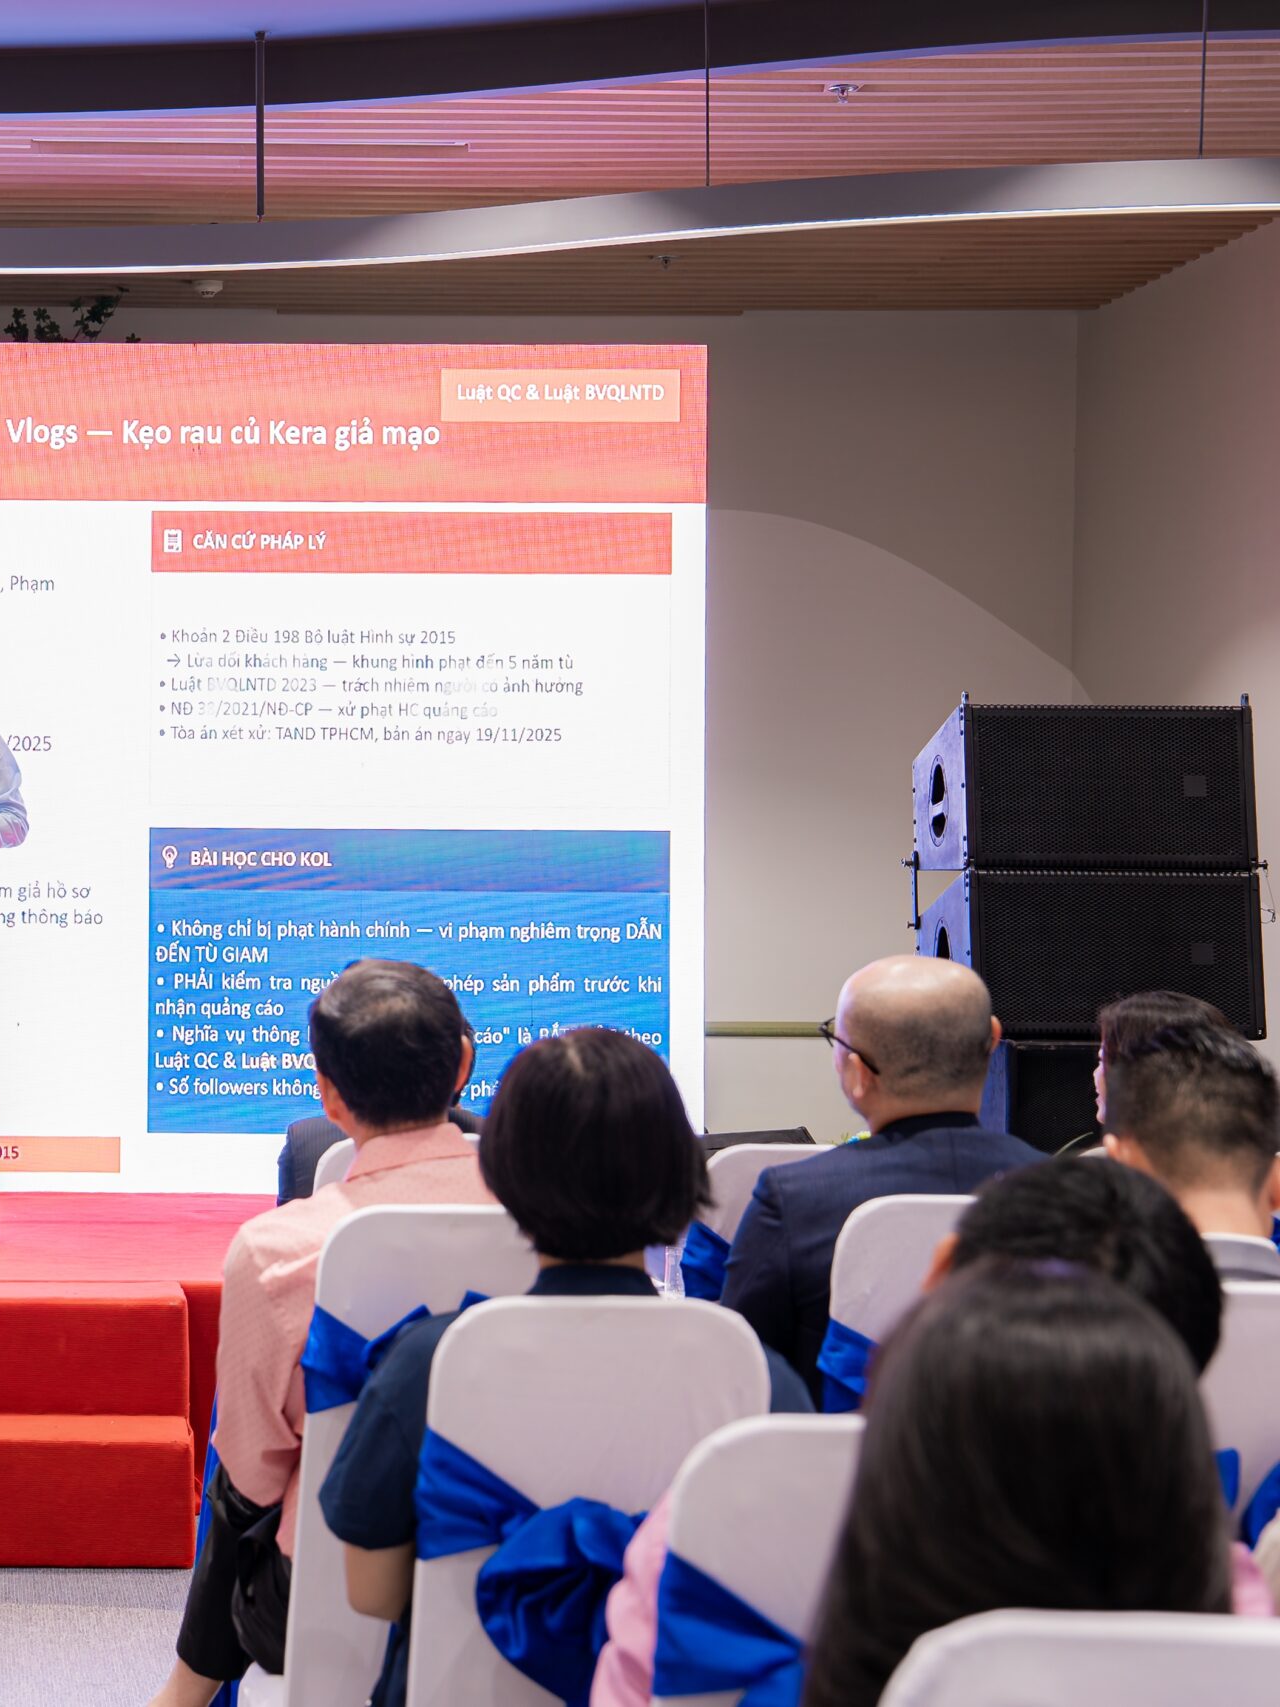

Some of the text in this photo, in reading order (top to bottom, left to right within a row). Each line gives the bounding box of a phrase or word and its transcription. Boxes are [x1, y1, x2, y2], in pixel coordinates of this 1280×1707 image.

[458, 383, 664, 405] Luật QC & Luật BVQLNTD
[6, 415, 77, 449] Vlogs
[123, 417, 171, 449] Kẹo
[181, 424, 221, 444] rau
[231, 416, 259, 444] củ
[270, 418, 326, 444] Kera
[335, 416, 373, 451] giả
[383, 425, 439, 451] mạo
[193, 530, 326, 551] CĂN CỨ PHÁP LÝ
[11, 575, 54, 594] Phạm
[223, 630, 230, 644] 2
[274, 630, 300, 644] 198
[420, 631, 455, 645] 2015
[353, 654, 517, 672] khung 5
[172, 677, 202, 695] Luật
[275, 727, 316, 741] TAND
[477, 727, 561, 745] 19/11/2025
[191, 848, 332, 870] BÀI HỌC CHO KOL
[172, 915, 661, 944] Không chỉ bị phạt hành chính vi phạm nghiêm trọng DẪN
[155, 940, 268, 964] ĐẾN TÙ GIAM
[175, 969, 212, 990] PHẢI
[222, 969, 260, 990] kiểm
[270, 976, 291, 991] tra
[492, 976, 519, 993] sản
[529, 972, 575, 997] phẩm
[584, 976, 629, 993] trước
[638, 977, 661, 993] khi
[156, 998, 284, 1020] nhận quảng cáo
[173, 1025, 218, 1046] Nghĩa
[225, 1031, 245, 1046] vụ
[252, 1026, 300, 1047] thông
[518, 1028, 533, 1045] là
[156, 1051, 189, 1073] Luật
[194, 1053, 218, 1072] QC
[223, 1053, 236, 1069] &
[242, 1052, 279, 1073] Luật
[169, 1073, 189, 1095] Số
[194, 1078, 268, 1096] followers
